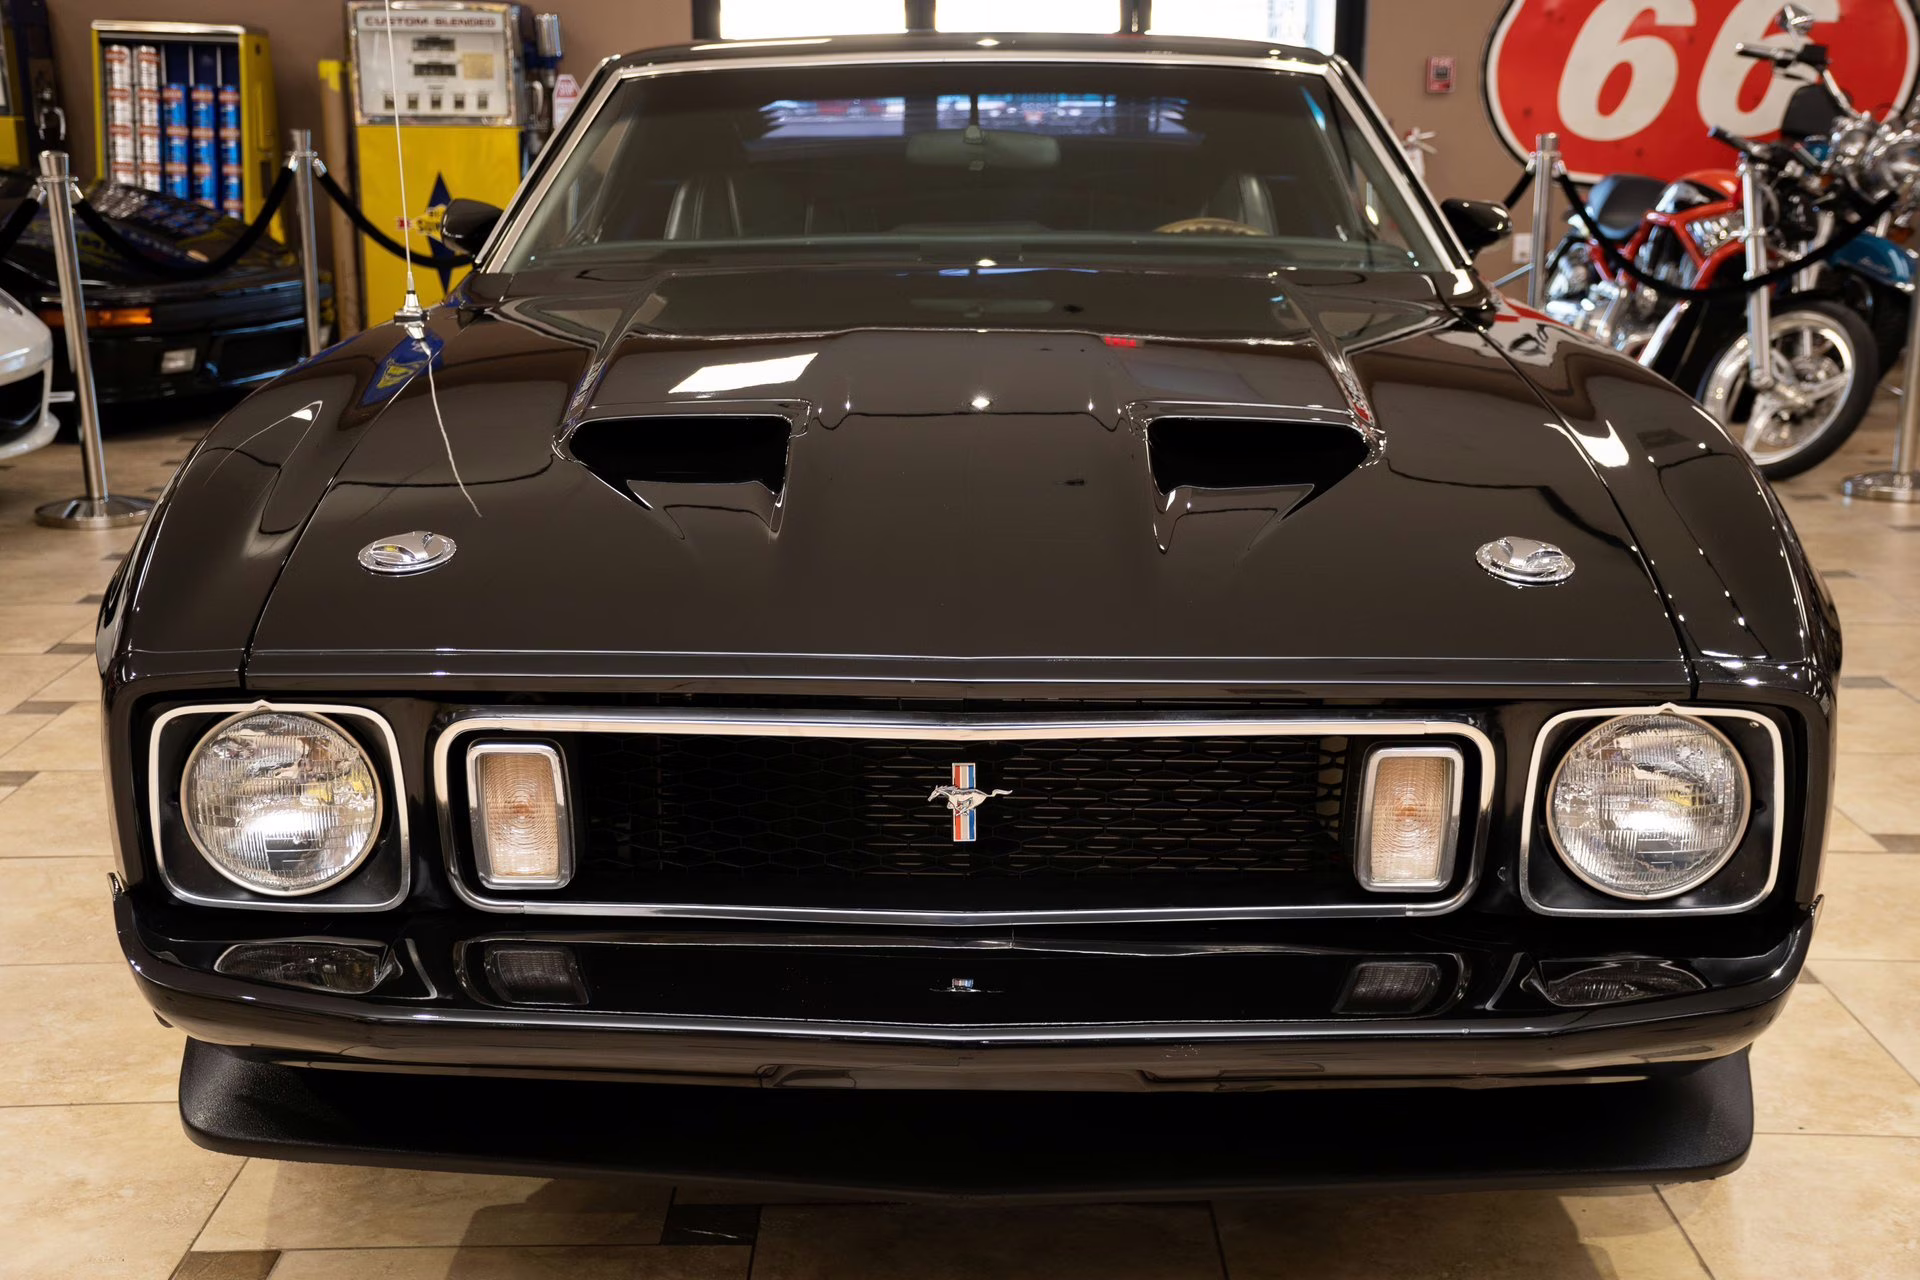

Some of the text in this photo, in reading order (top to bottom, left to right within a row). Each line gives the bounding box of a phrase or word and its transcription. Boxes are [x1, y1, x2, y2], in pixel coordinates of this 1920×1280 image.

[364, 16, 497, 28] CUSTOM BLENDED
[1557, 0, 1840, 142] 66
